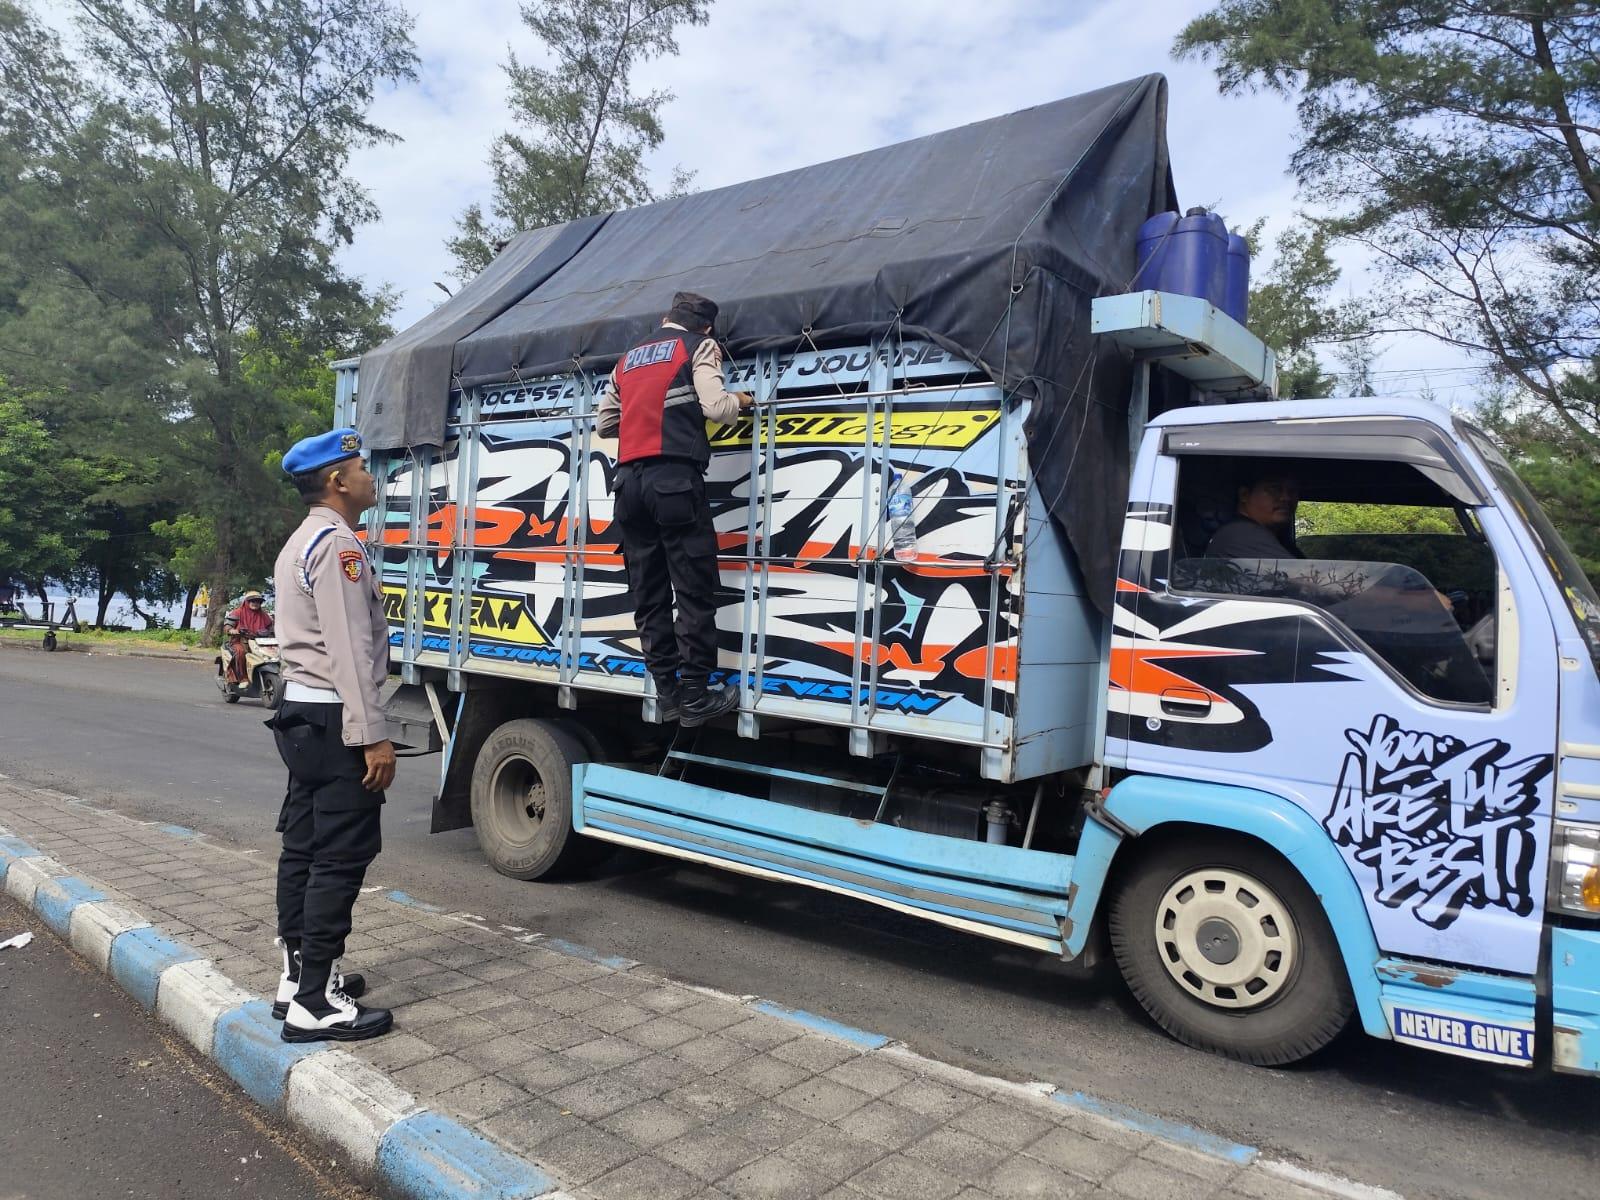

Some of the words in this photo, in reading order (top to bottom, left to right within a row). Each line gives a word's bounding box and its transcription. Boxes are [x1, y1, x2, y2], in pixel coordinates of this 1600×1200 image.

[626, 341, 674, 366] POLISI
[466, 384, 562, 406] ROCESS
[444, 597, 526, 632] TEAM
[1323, 752, 1445, 846] ARE
[1431, 738, 1553, 838] THE
[1400, 1011, 1467, 1046] NEVER
[1471, 1024, 1523, 1056] GIVE
